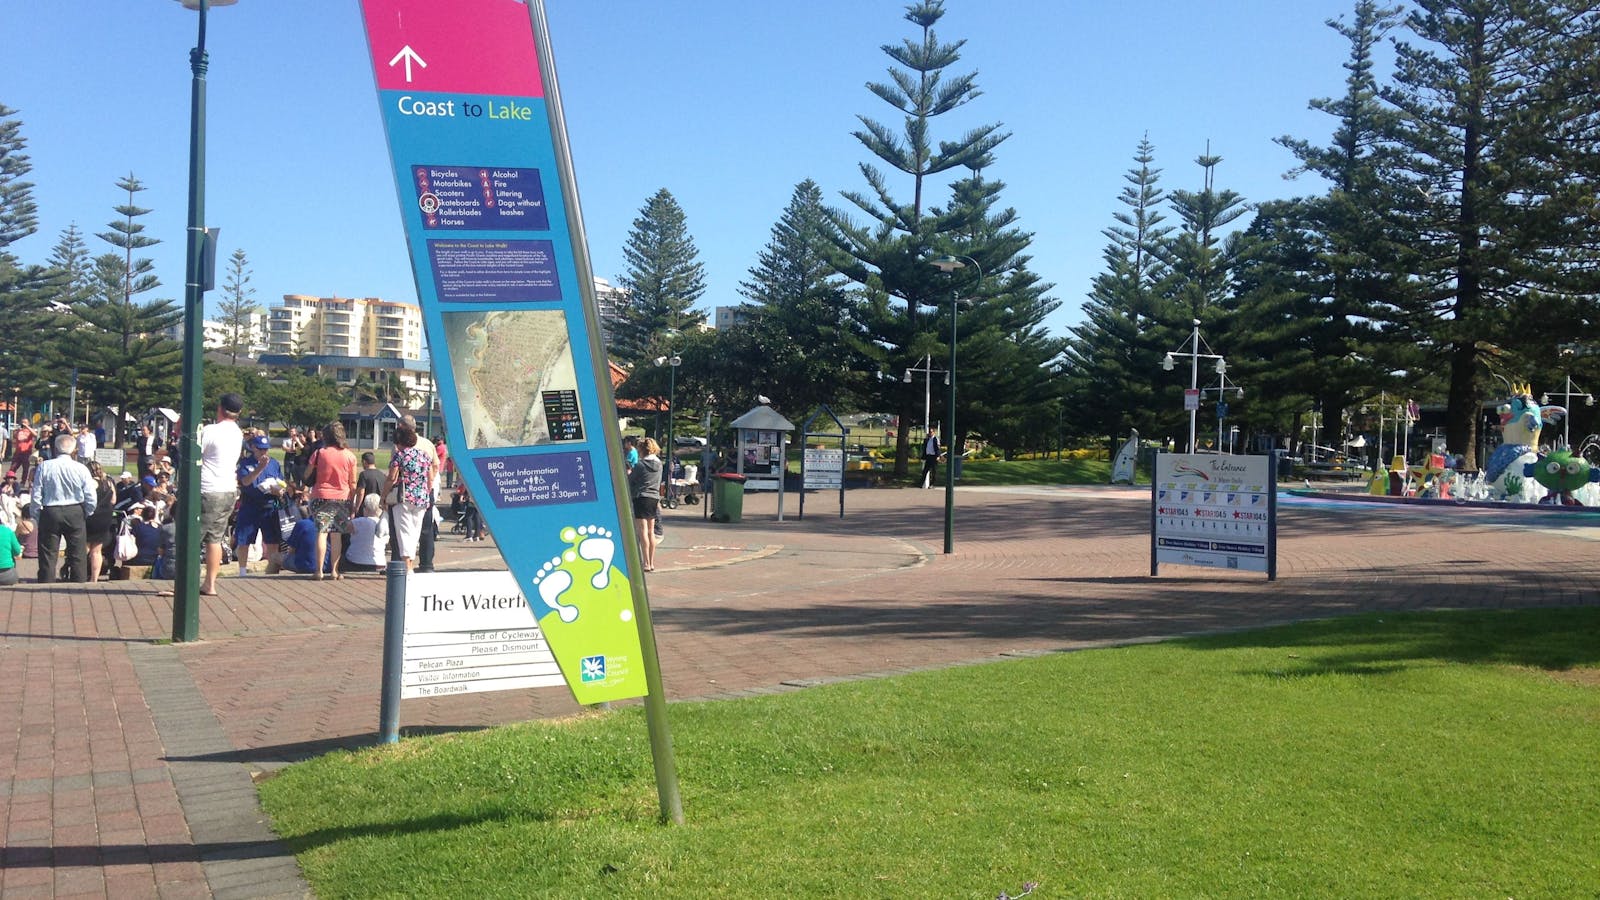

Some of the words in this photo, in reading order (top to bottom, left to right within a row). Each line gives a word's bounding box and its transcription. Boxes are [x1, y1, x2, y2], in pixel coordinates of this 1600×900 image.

[398, 96, 454, 117] Coast
[463, 102, 482, 117] to
[489, 101, 532, 120] Lake
[431, 170, 458, 179] Bicycles
[488, 462, 504, 470] BBQ
[517, 468, 558, 476] Information
[504, 494, 530, 502] Pelican
[420, 594, 454, 612] The
[470, 632, 485, 641] End
[502, 631, 539, 640] Cycleway
[472, 645, 498, 654] Please
[502, 643, 539, 652] Dismount
[434, 685, 468, 694] Boardwalk
